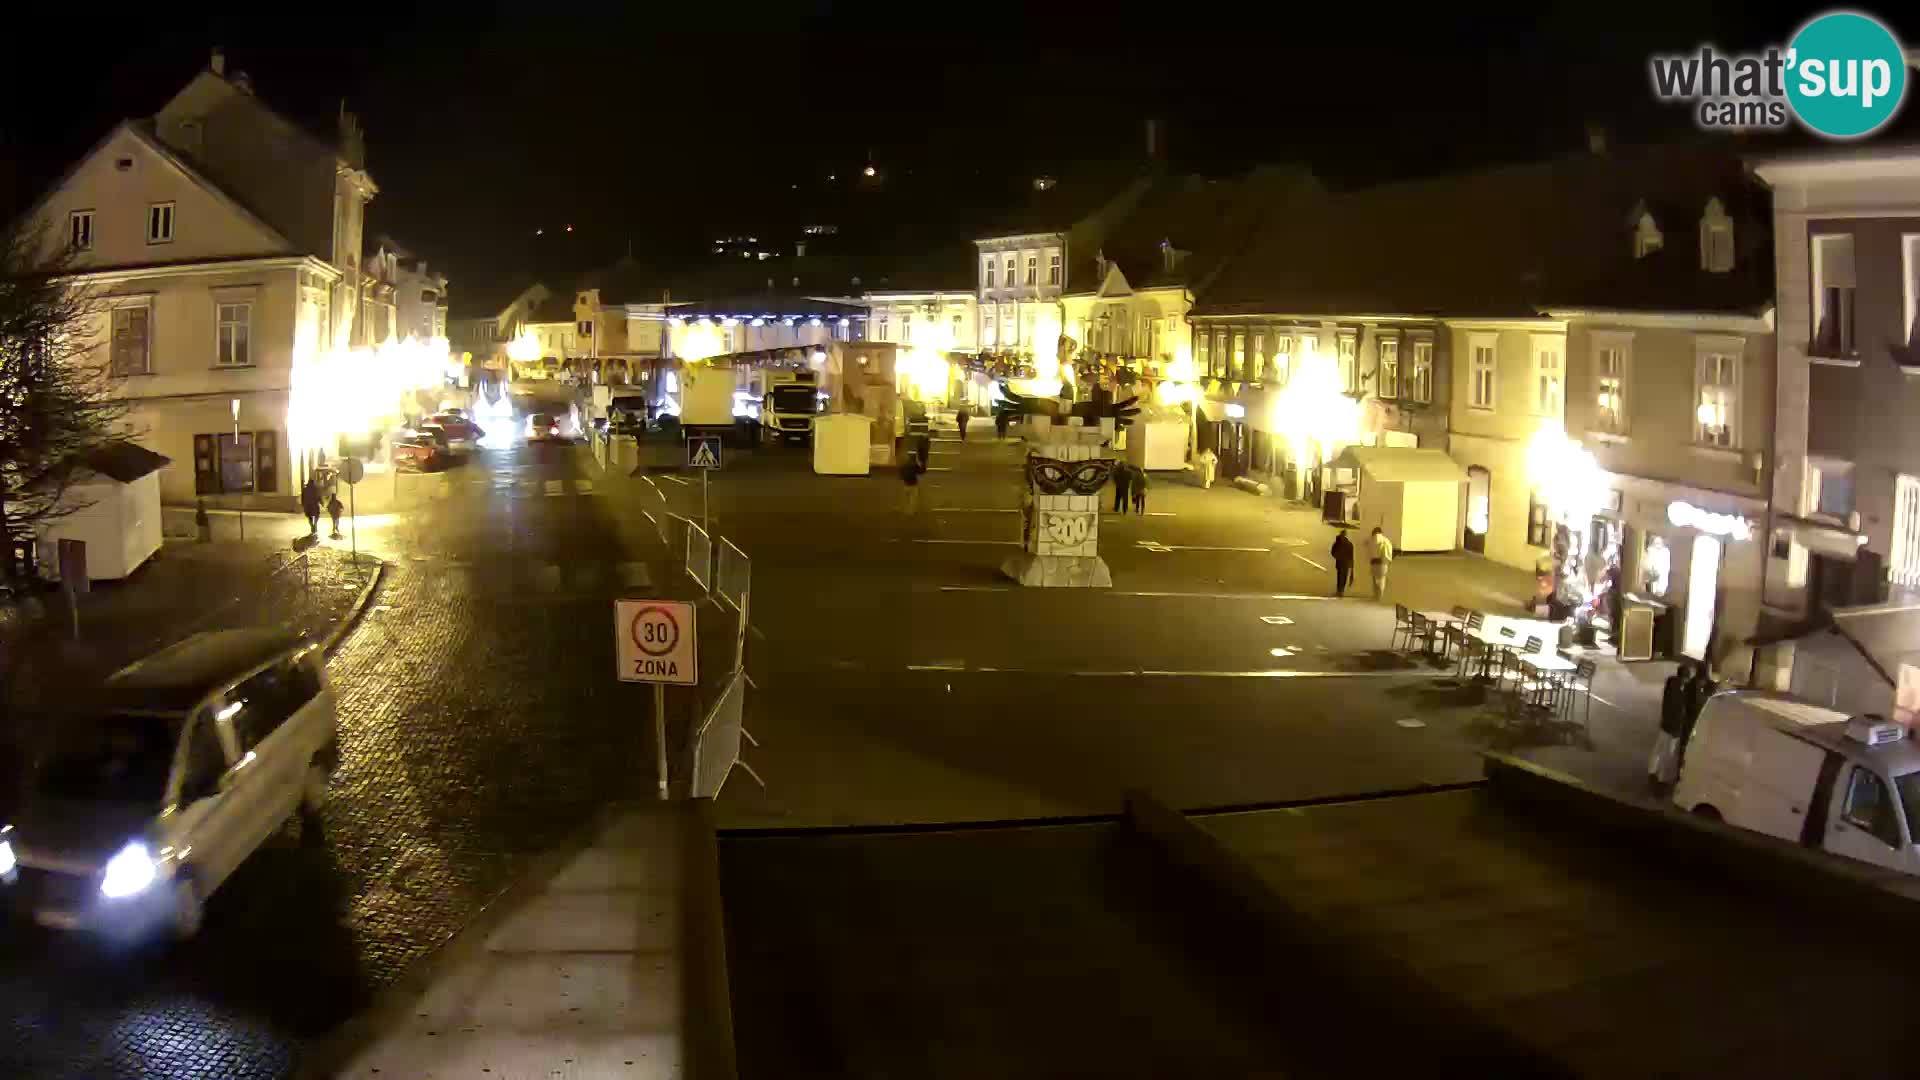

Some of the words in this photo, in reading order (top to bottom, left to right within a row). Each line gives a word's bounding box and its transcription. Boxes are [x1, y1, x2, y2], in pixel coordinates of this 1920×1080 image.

[1048, 515, 1088, 546] 200
[644, 622, 668, 643] 30
[634, 659, 679, 677] ZONA
